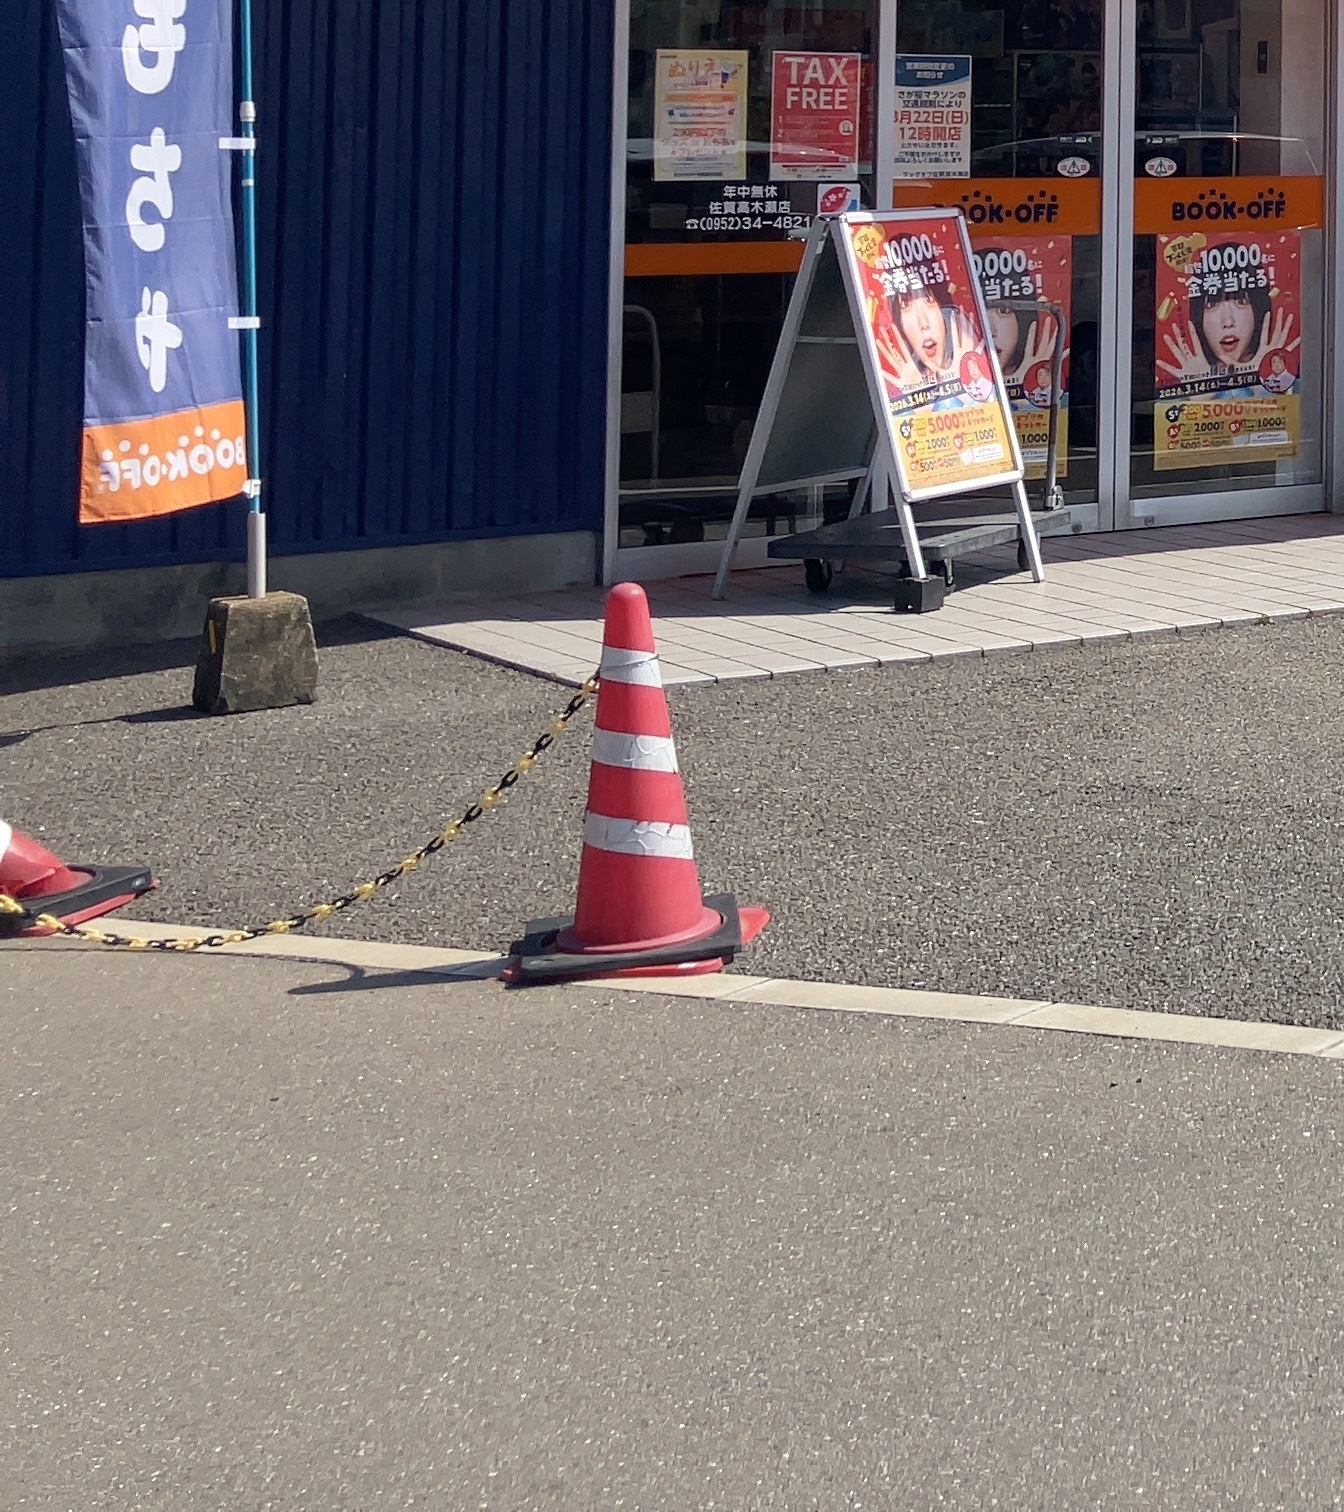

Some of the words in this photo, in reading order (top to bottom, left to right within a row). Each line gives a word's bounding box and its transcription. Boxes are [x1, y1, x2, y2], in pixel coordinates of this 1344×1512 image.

[782, 57, 849, 85] TAX
[786, 88, 849, 110] FREE
[899, 127, 962, 141] 12時開店
[723, 185, 778, 199] 年中無休
[709, 201, 791, 215] 佐賀高木瀬店
[1185, 267, 1276, 299] 金券当たる!
